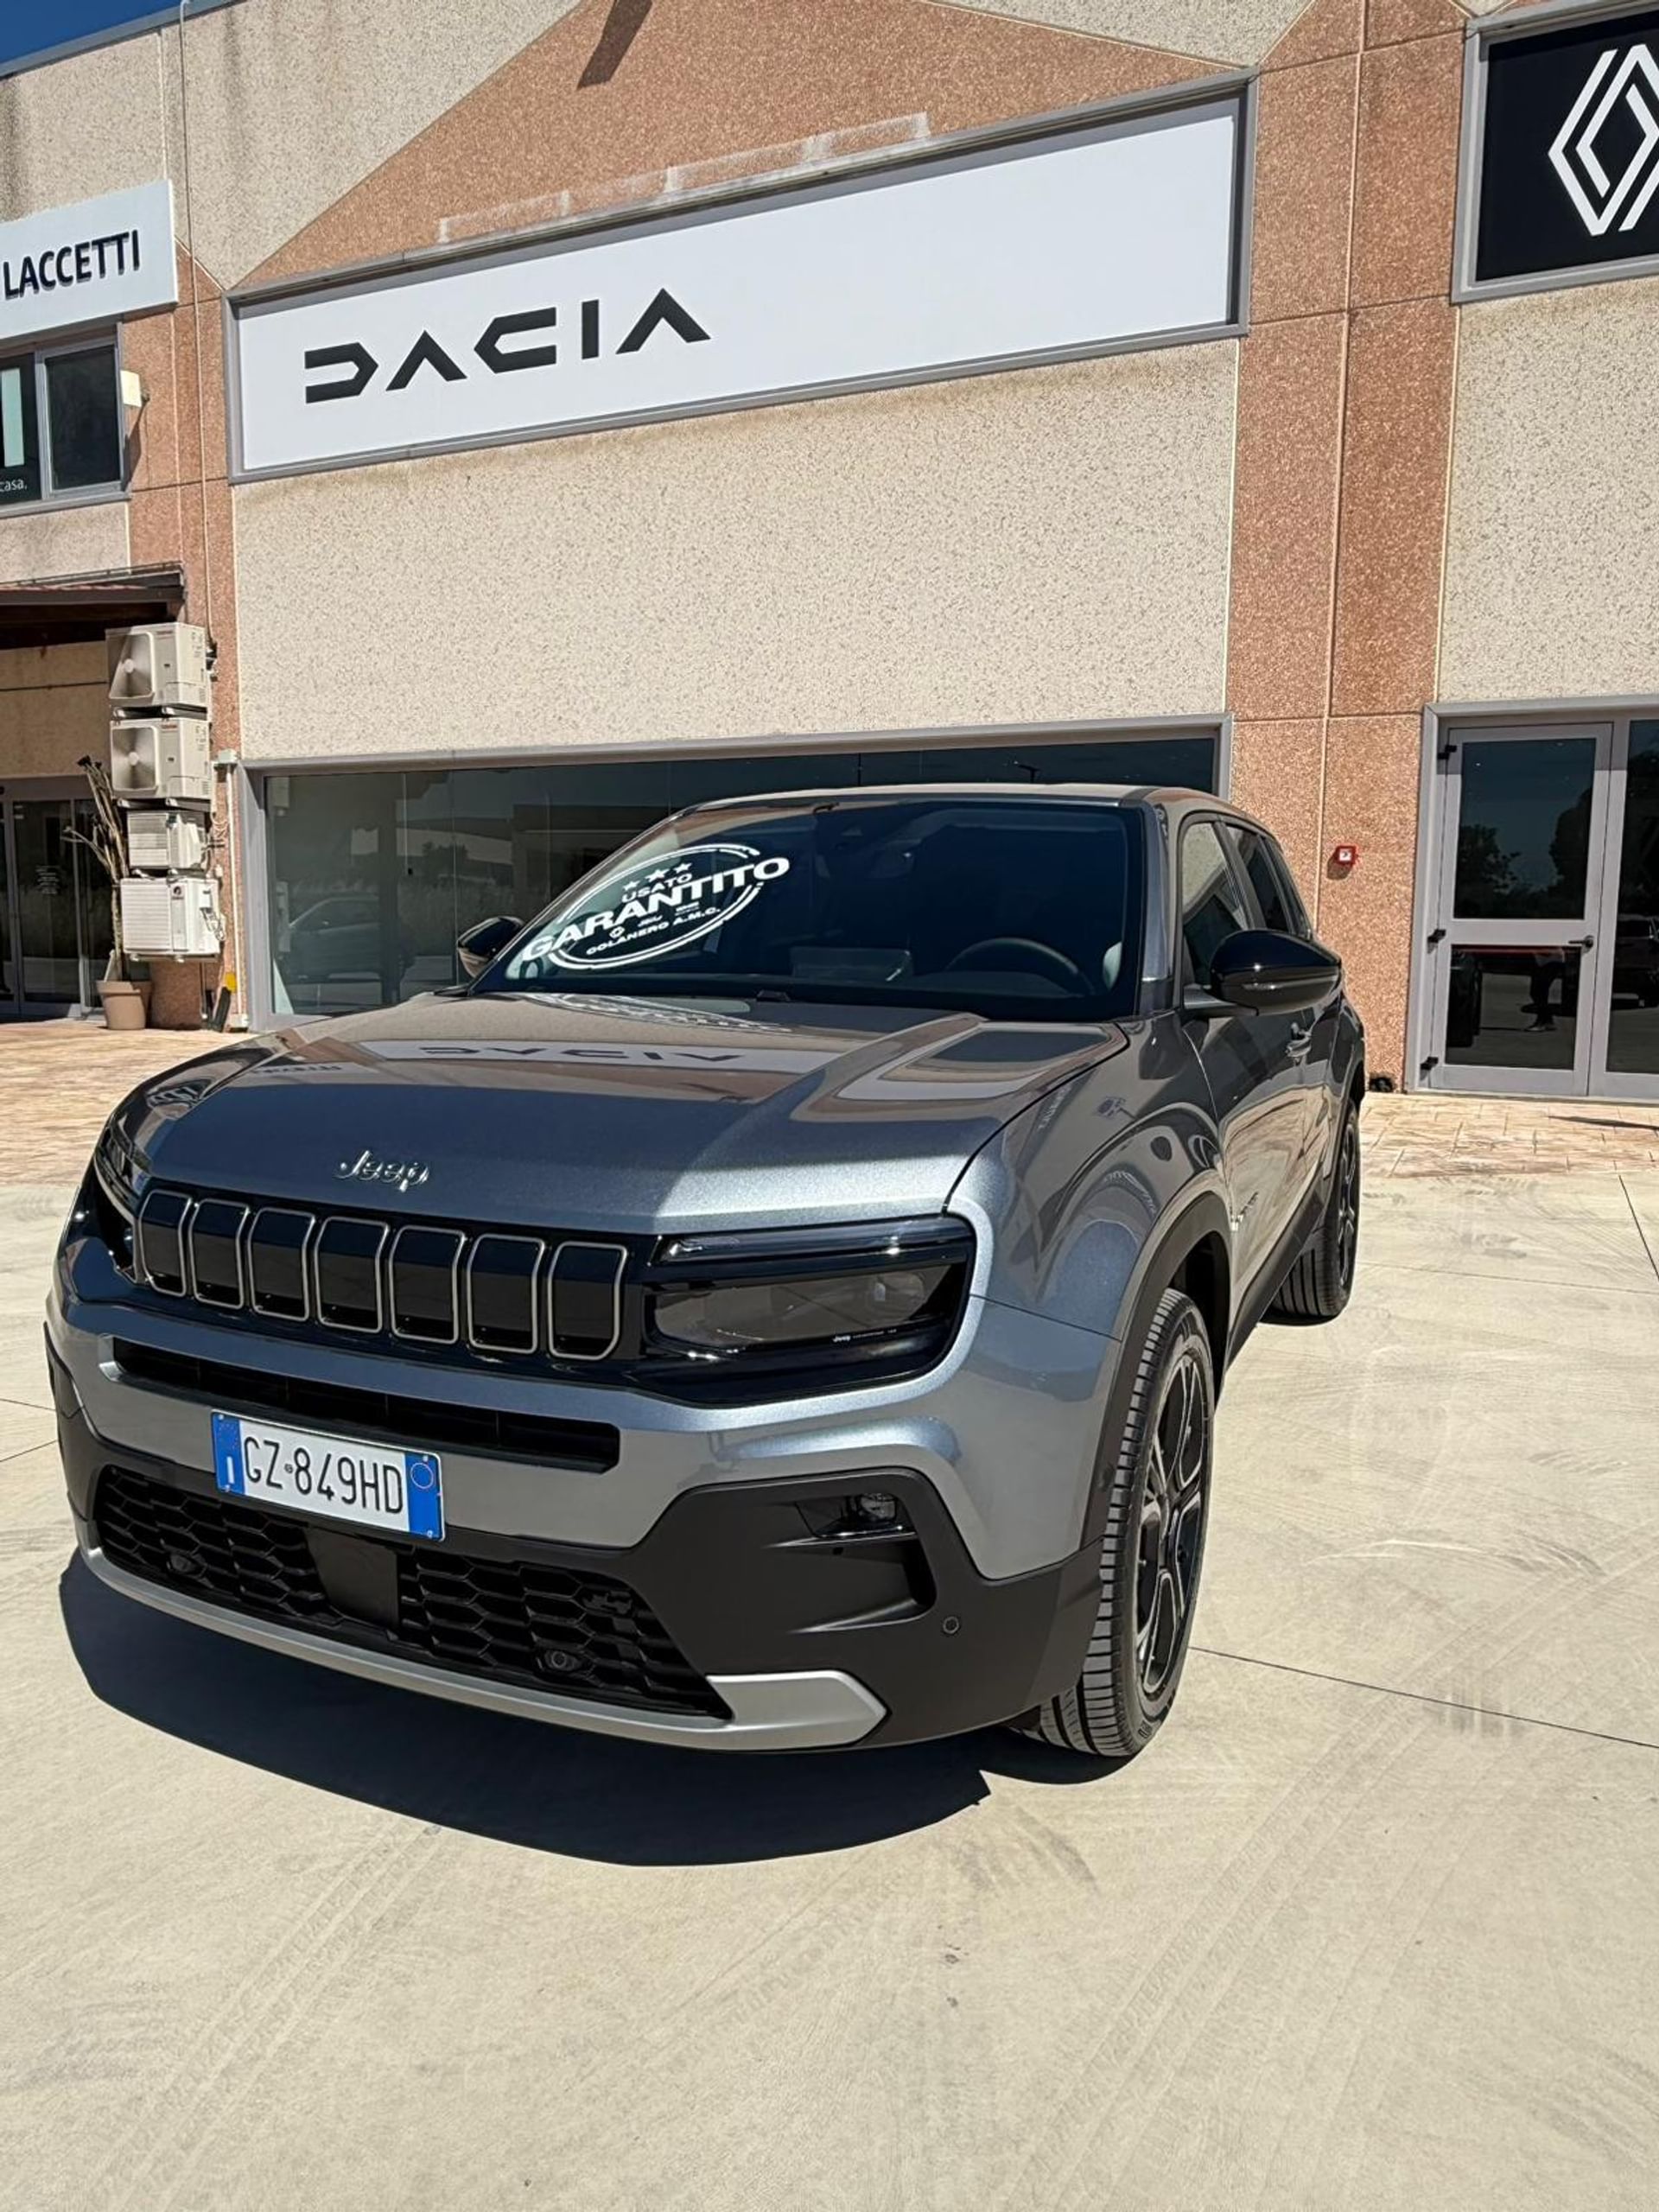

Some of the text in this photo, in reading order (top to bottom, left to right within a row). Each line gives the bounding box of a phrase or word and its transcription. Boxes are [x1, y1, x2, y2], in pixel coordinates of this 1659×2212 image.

[3, 229, 140, 300] LACCETTI
[304, 288, 711, 404] DACIA
[523, 857, 791, 962] GARANTITO
[621, 874, 692, 903] USATO
[334, 1150, 429, 1192] Jeep
